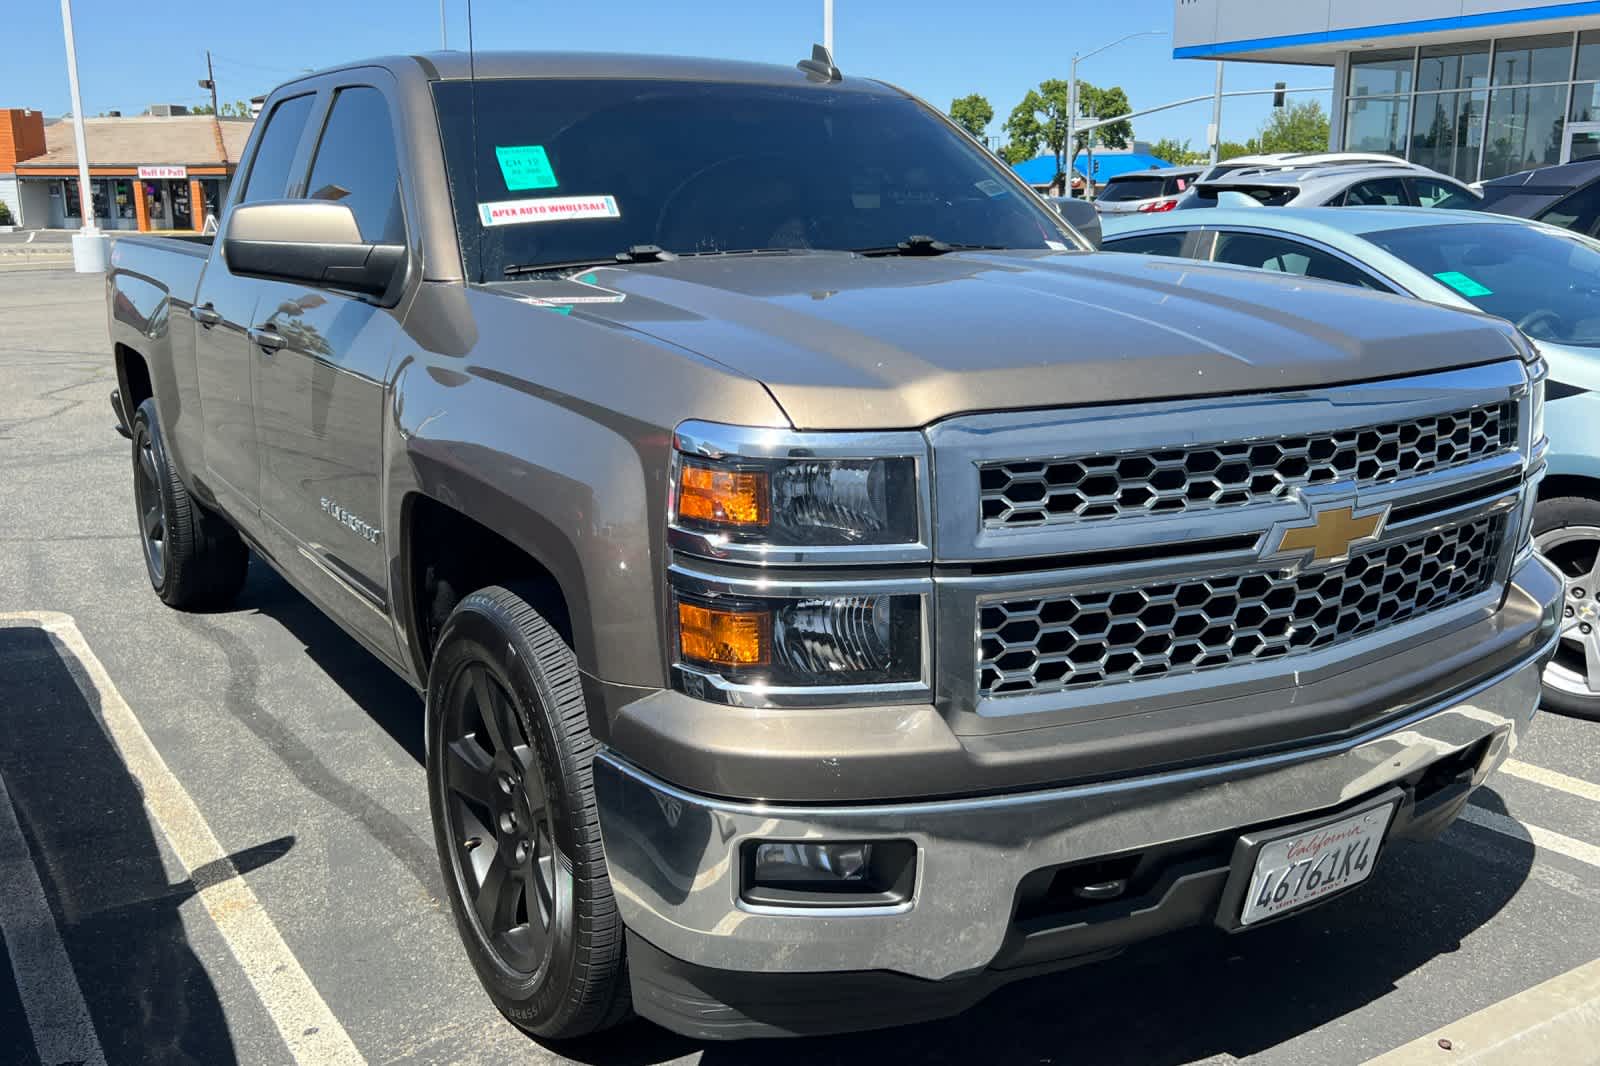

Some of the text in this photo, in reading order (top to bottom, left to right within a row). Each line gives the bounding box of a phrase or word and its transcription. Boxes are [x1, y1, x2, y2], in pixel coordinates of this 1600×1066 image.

[492, 202, 607, 218] APEX AUTO WHOLESALE
[1287, 825, 1363, 859] California
[1256, 838, 1370, 907] 46761K4
